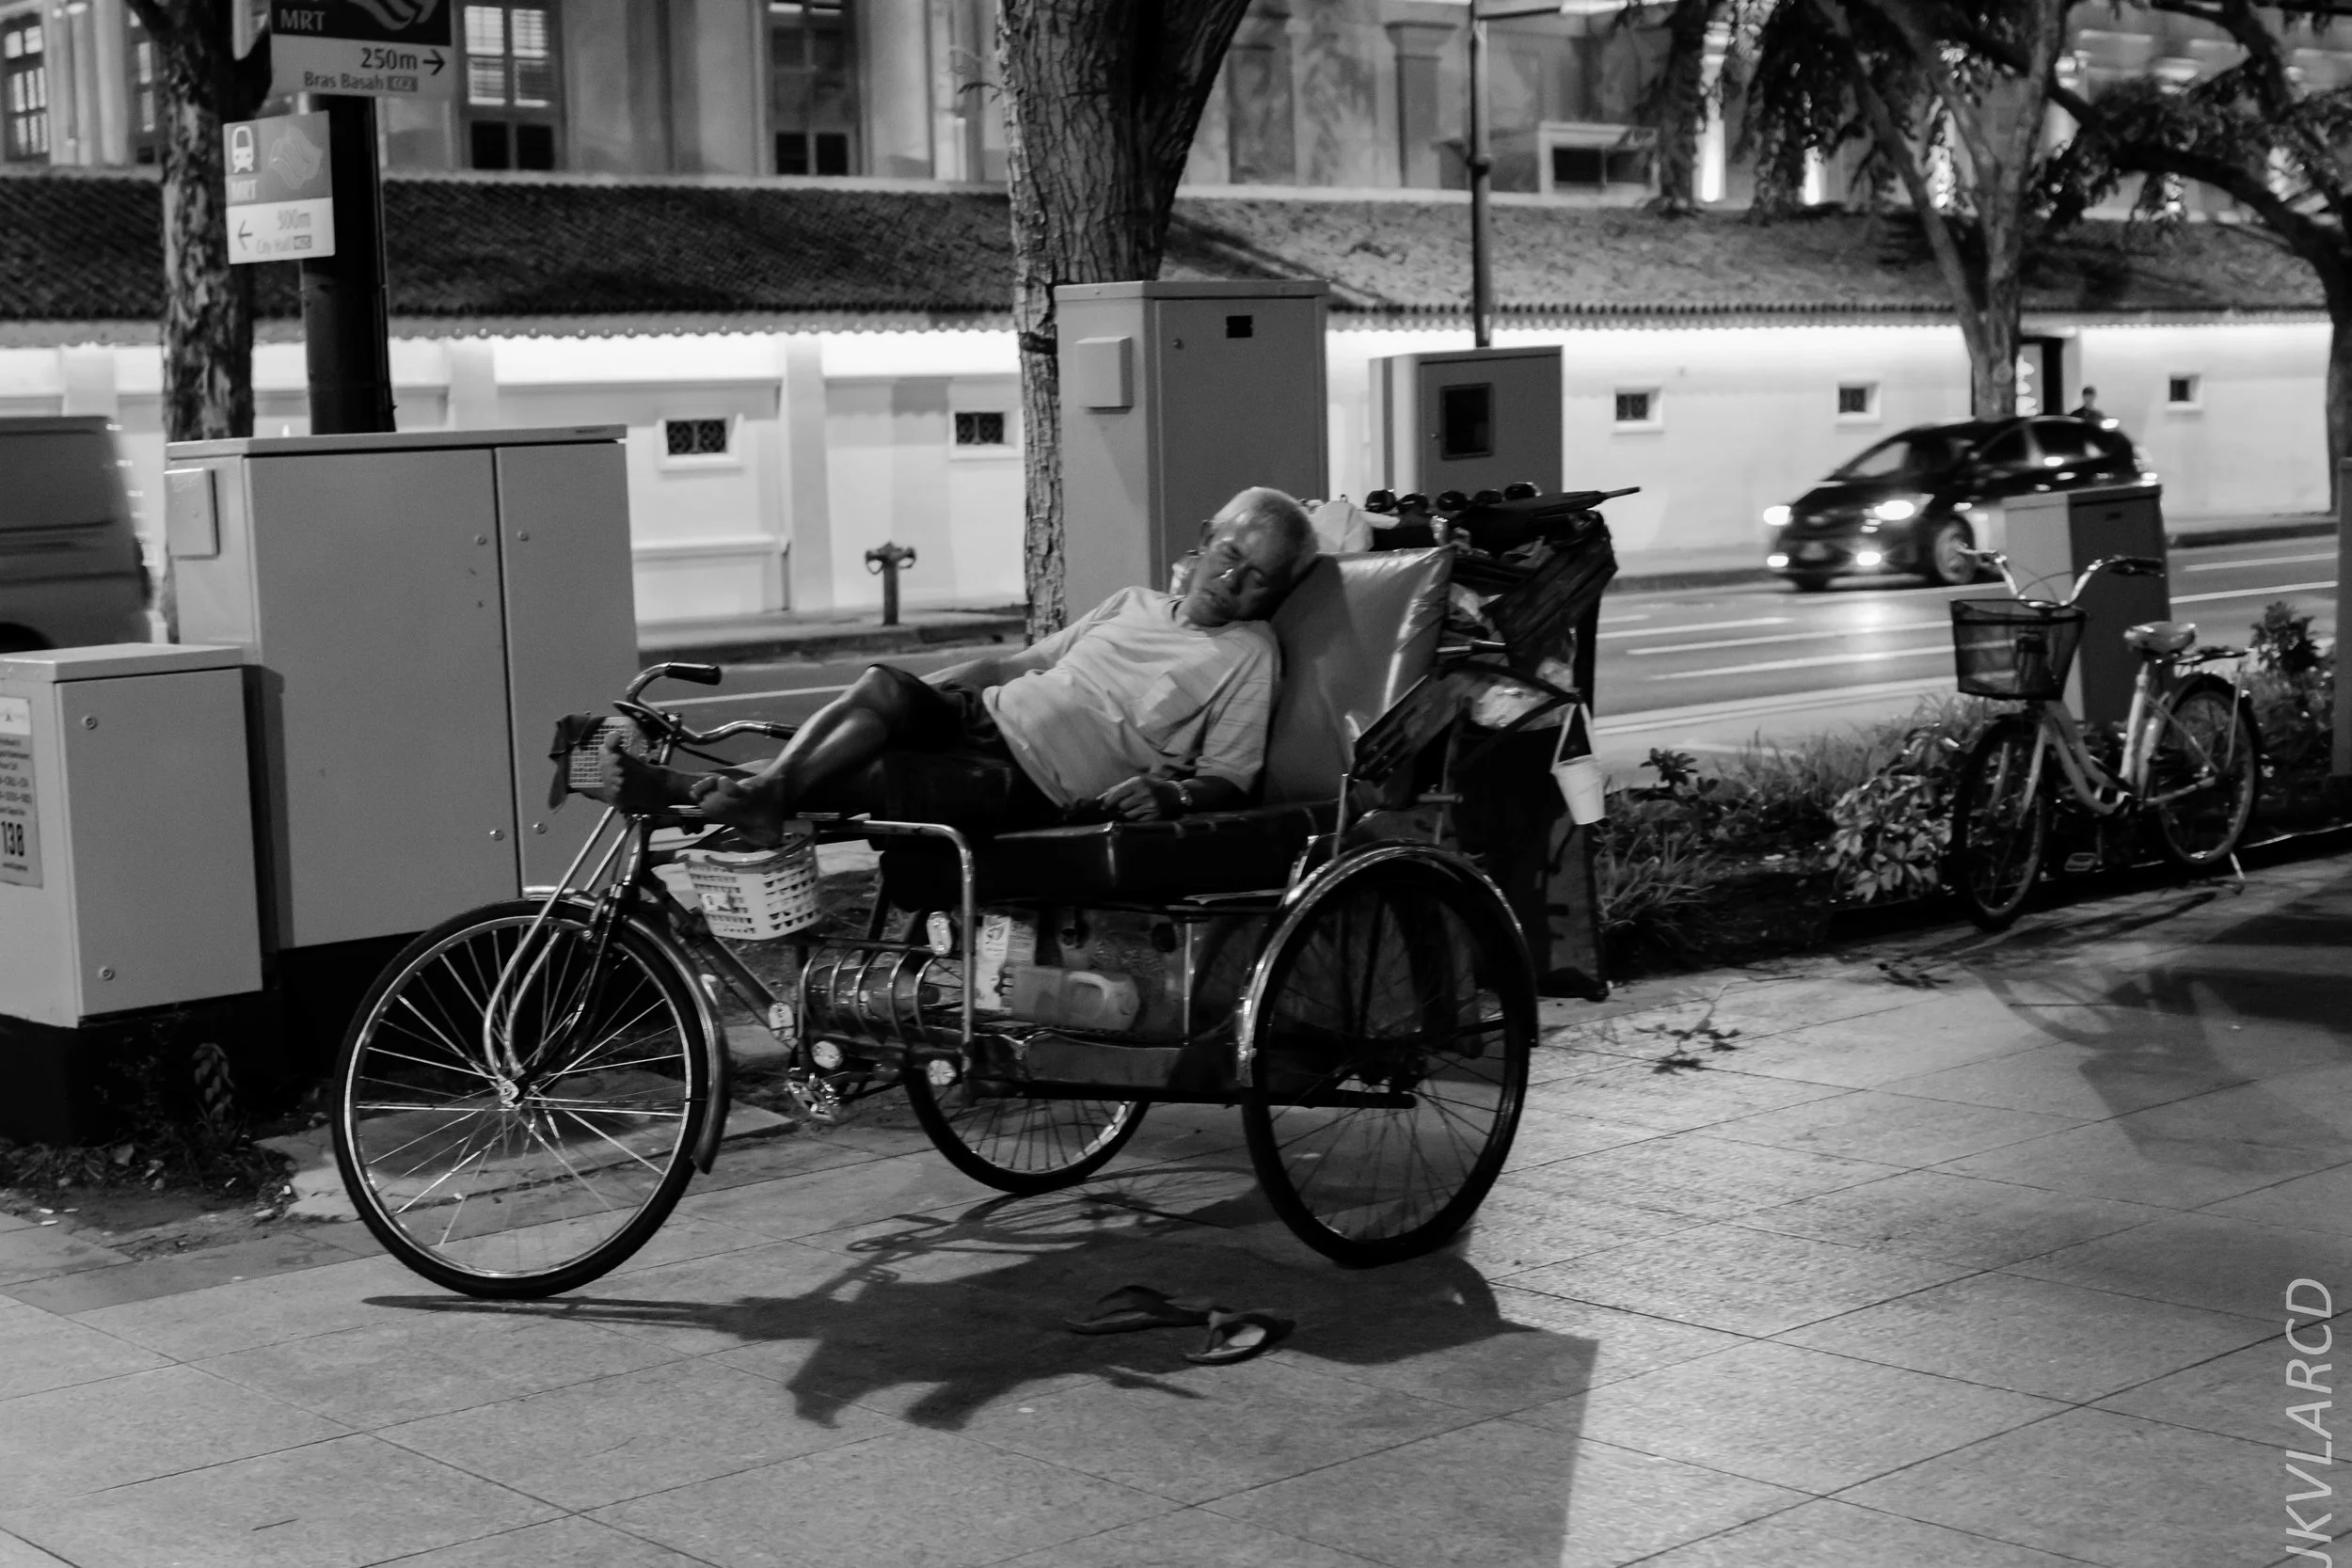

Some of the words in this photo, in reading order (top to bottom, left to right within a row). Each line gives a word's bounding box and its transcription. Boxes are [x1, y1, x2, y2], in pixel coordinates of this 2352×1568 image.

[281, 8, 326, 31] MRT
[360, 47, 418, 71] 250m
[304, 71, 337, 88] Bras
[341, 73, 384, 90] Basah
